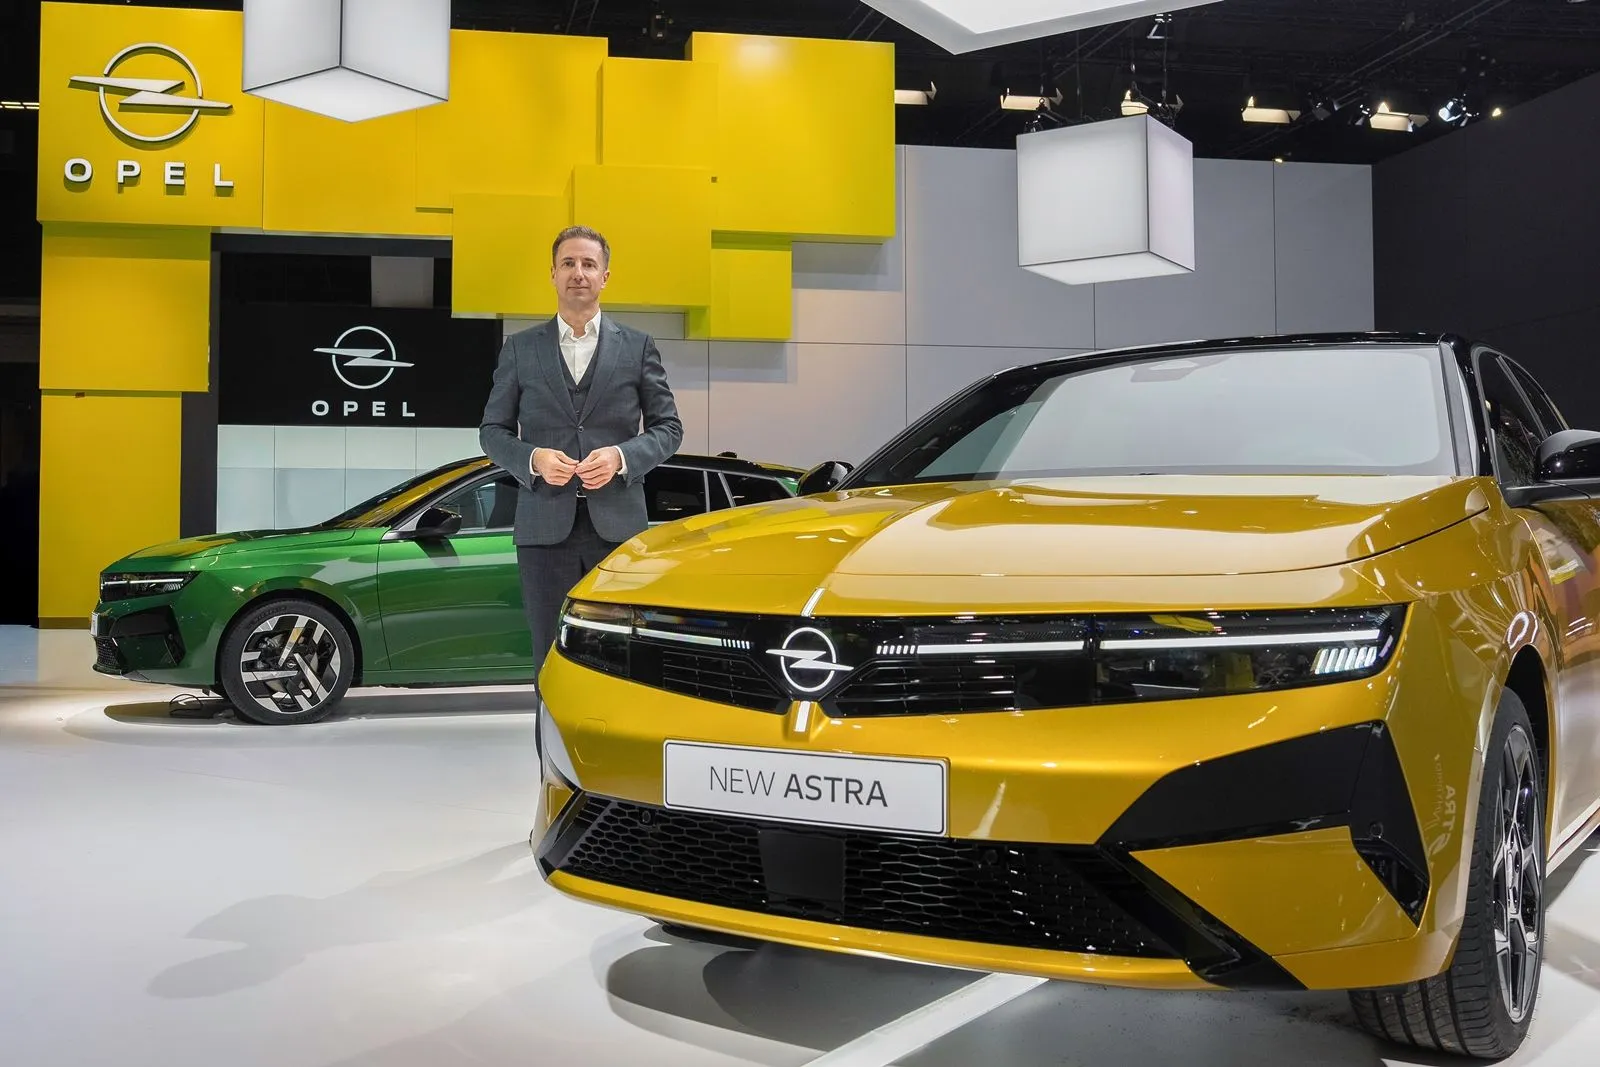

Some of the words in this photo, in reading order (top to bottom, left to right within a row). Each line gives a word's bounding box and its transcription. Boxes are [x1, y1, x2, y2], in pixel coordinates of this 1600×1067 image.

[64, 157, 234, 187] OPEL
[311, 399, 416, 417] OPEL
[709, 765, 775, 797] NEW
[783, 773, 888, 807] ASTRA
